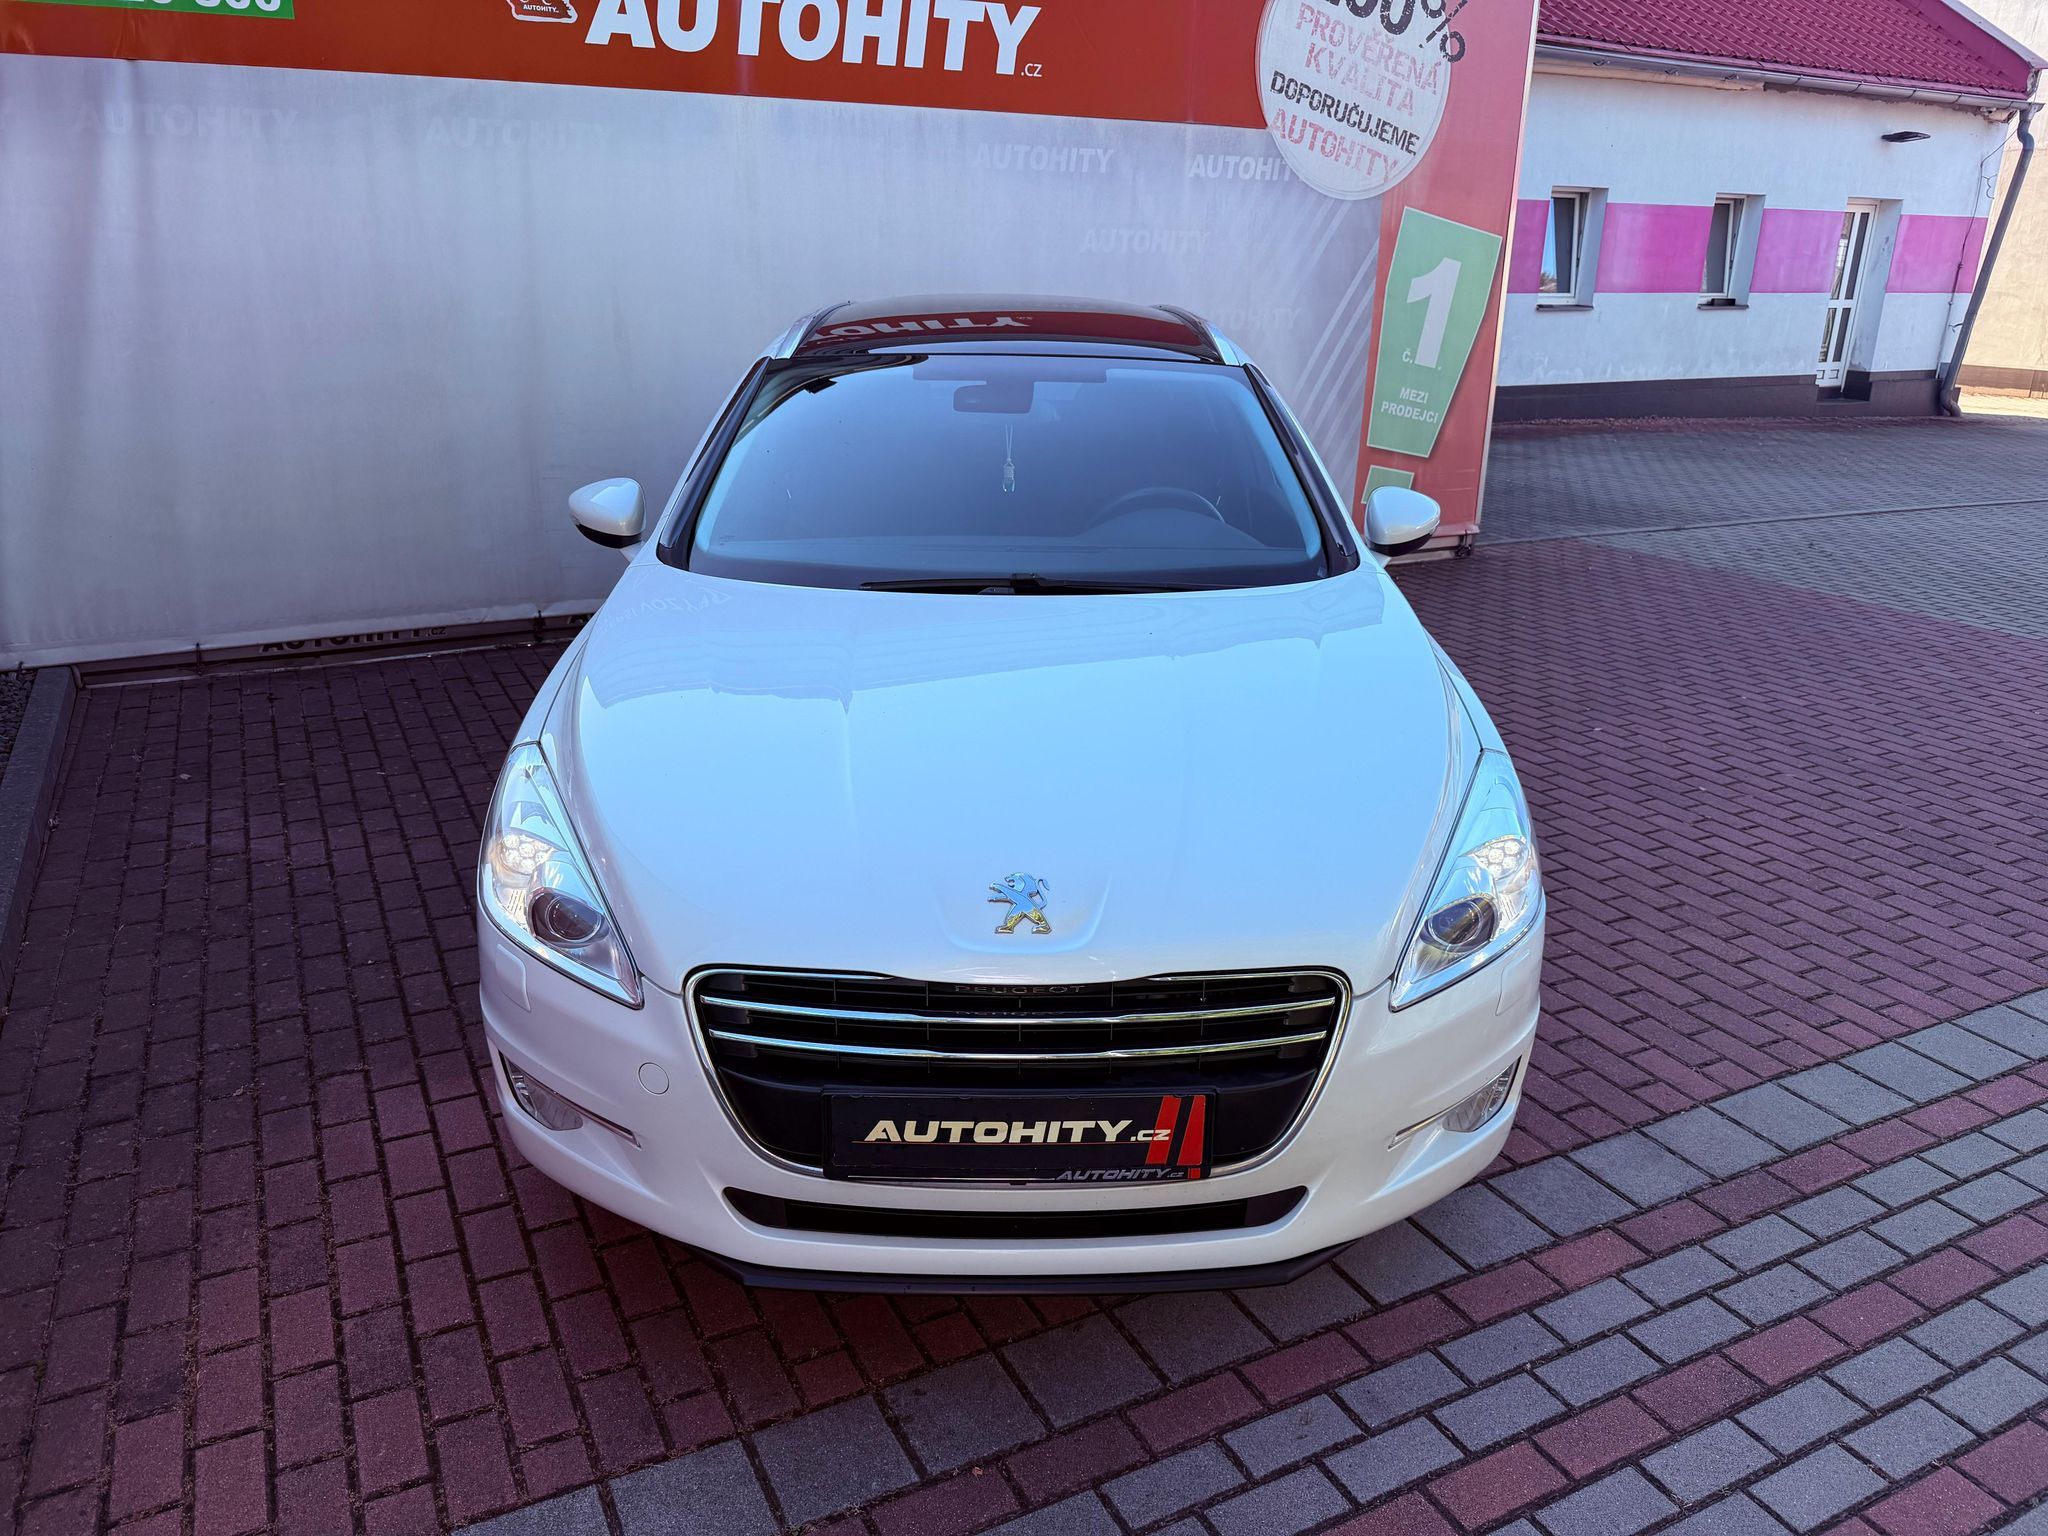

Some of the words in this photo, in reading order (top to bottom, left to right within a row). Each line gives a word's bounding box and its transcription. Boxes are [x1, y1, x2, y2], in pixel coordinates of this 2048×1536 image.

[1295, 3, 1442, 96] PROVĚŘENÁ
[1304, 42, 1415, 117] KVALITA
[1270, 70, 1420, 156] DOPORUČUJEME
[973, 143, 1113, 174] AUTOHITY
[1271, 108, 1399, 183] AUTOHITY
[1080, 229, 1209, 255] AUTOHITY
[1400, 388, 1429, 404] MEZI
[1381, 401, 1439, 423] PRODEJCI
[954, 985, 1086, 994] PEUGEOT
